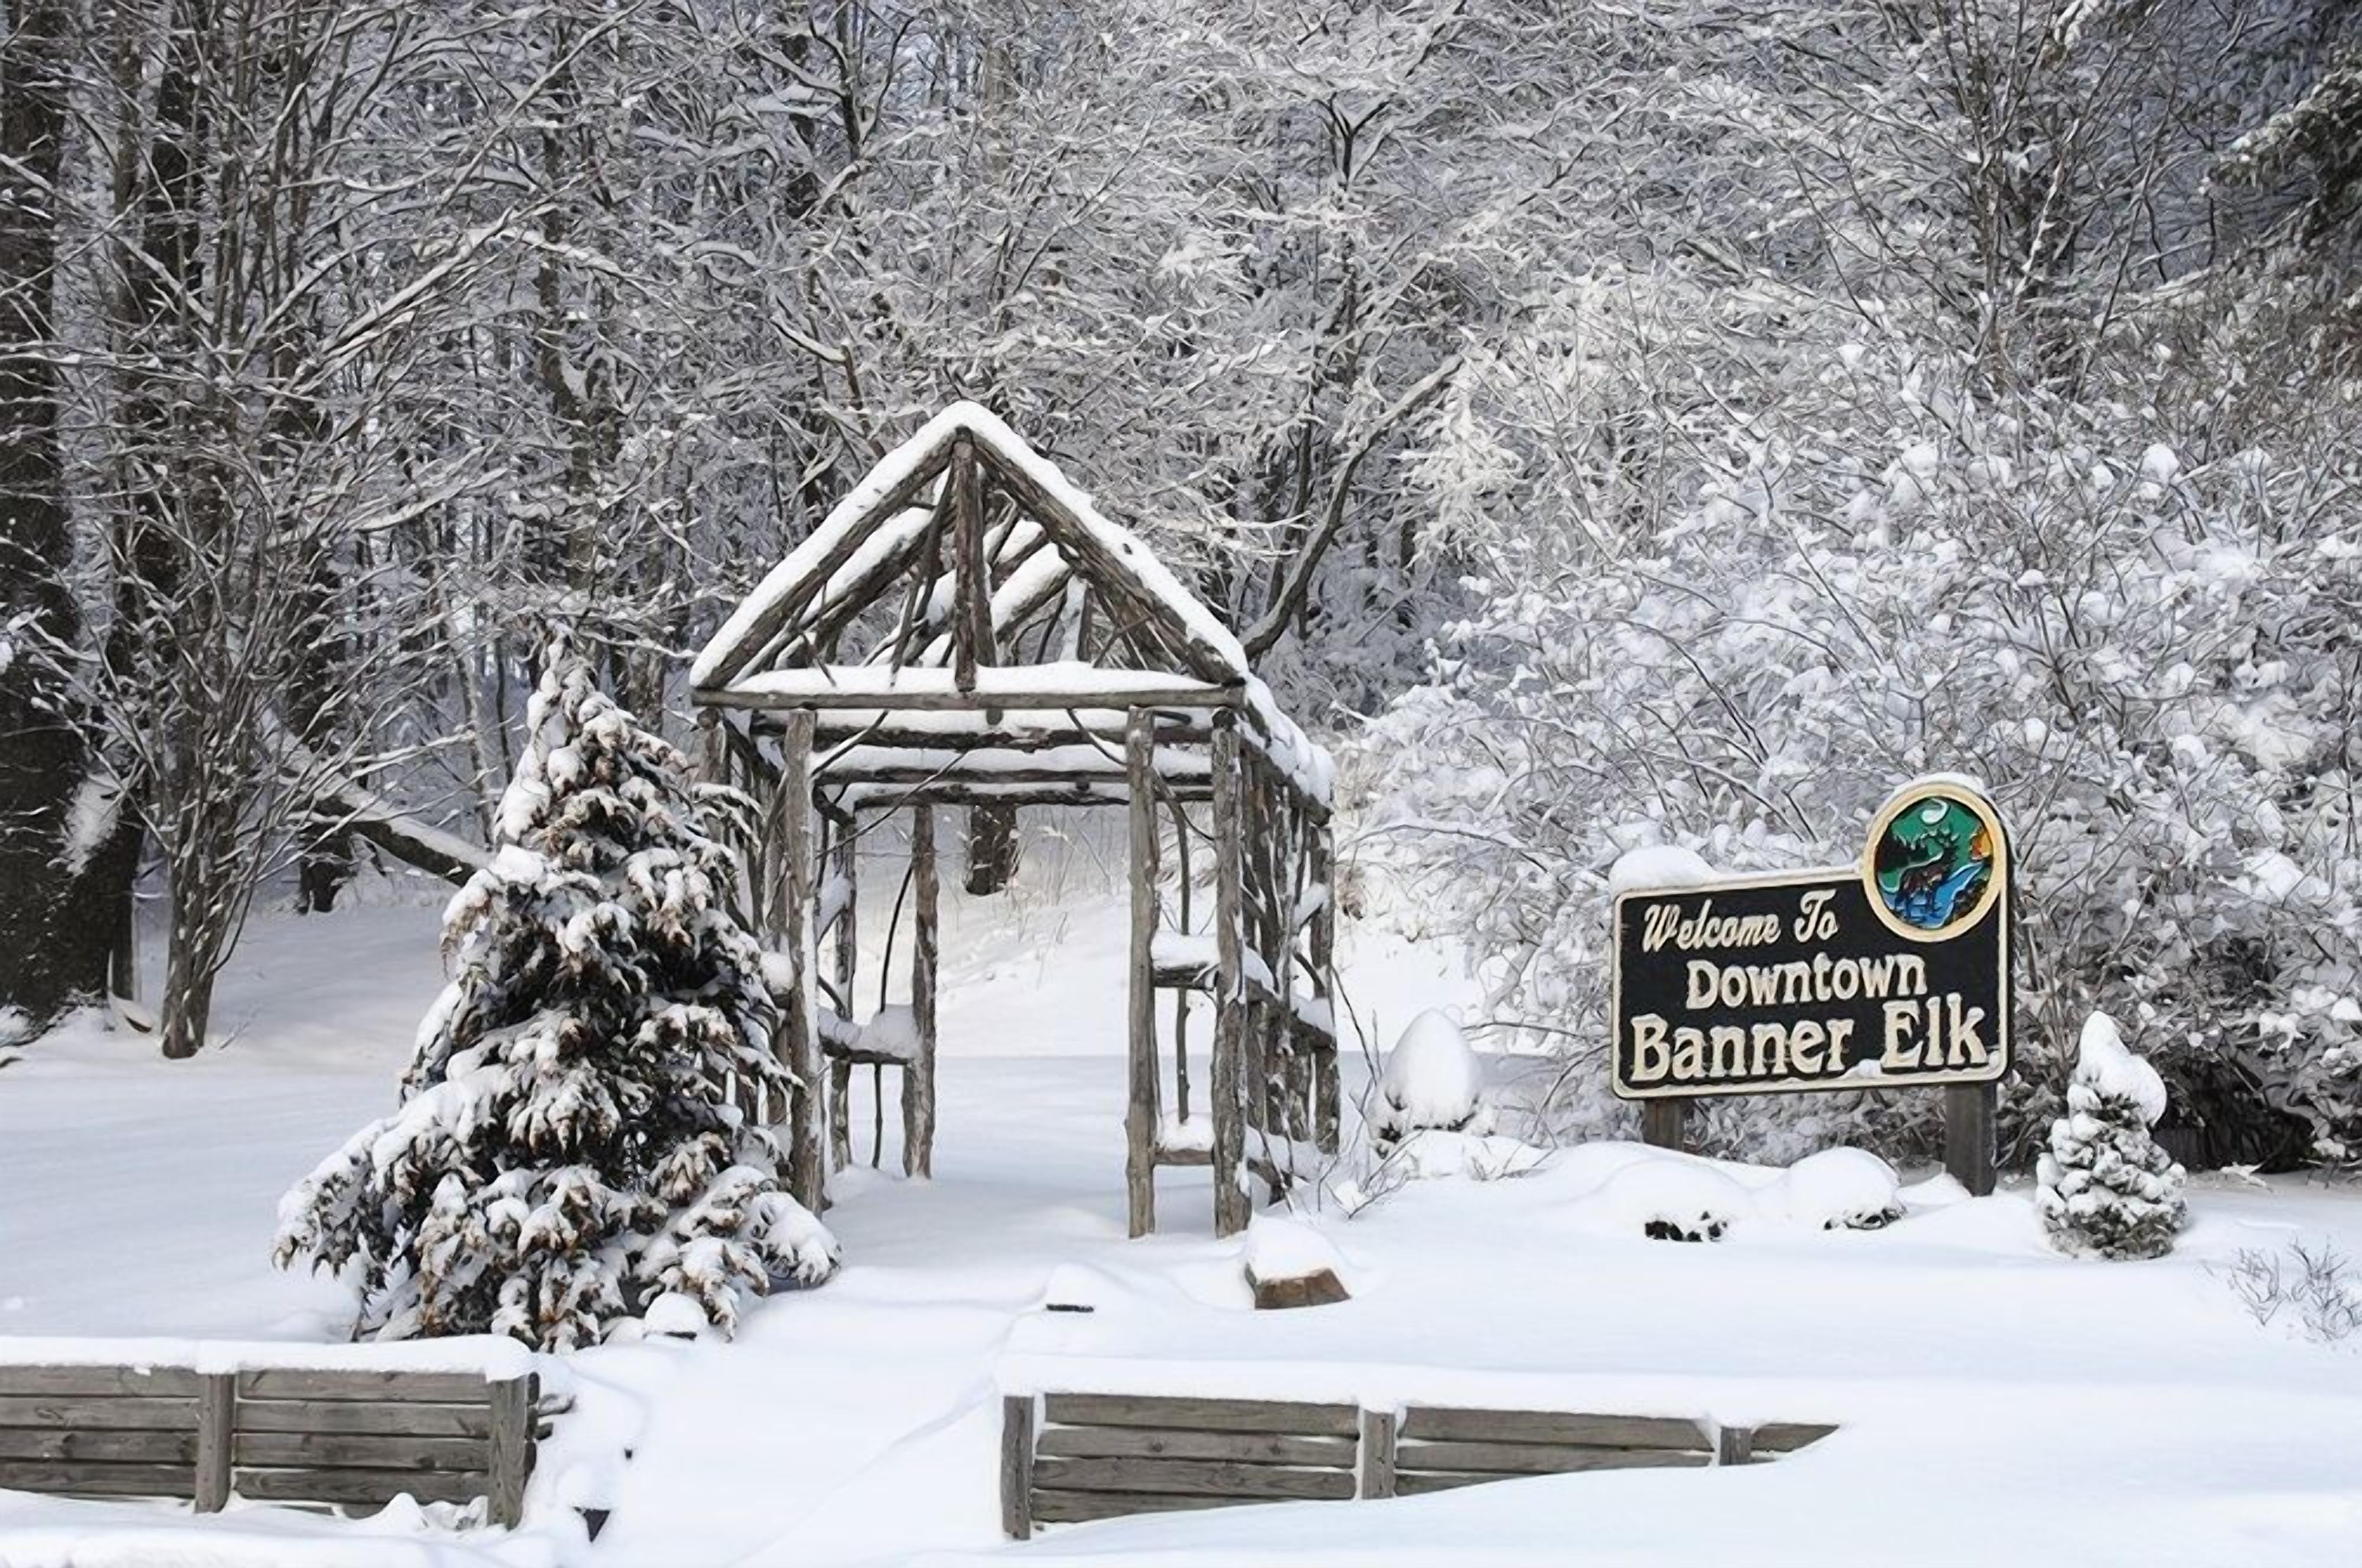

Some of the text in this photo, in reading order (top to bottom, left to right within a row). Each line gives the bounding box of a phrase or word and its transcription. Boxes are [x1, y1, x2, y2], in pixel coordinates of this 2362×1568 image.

[1642, 890, 1839, 952] Welcome To
[1686, 952, 1927, 1010] Downtown
[1630, 992, 1988, 1082] Banner Elk
